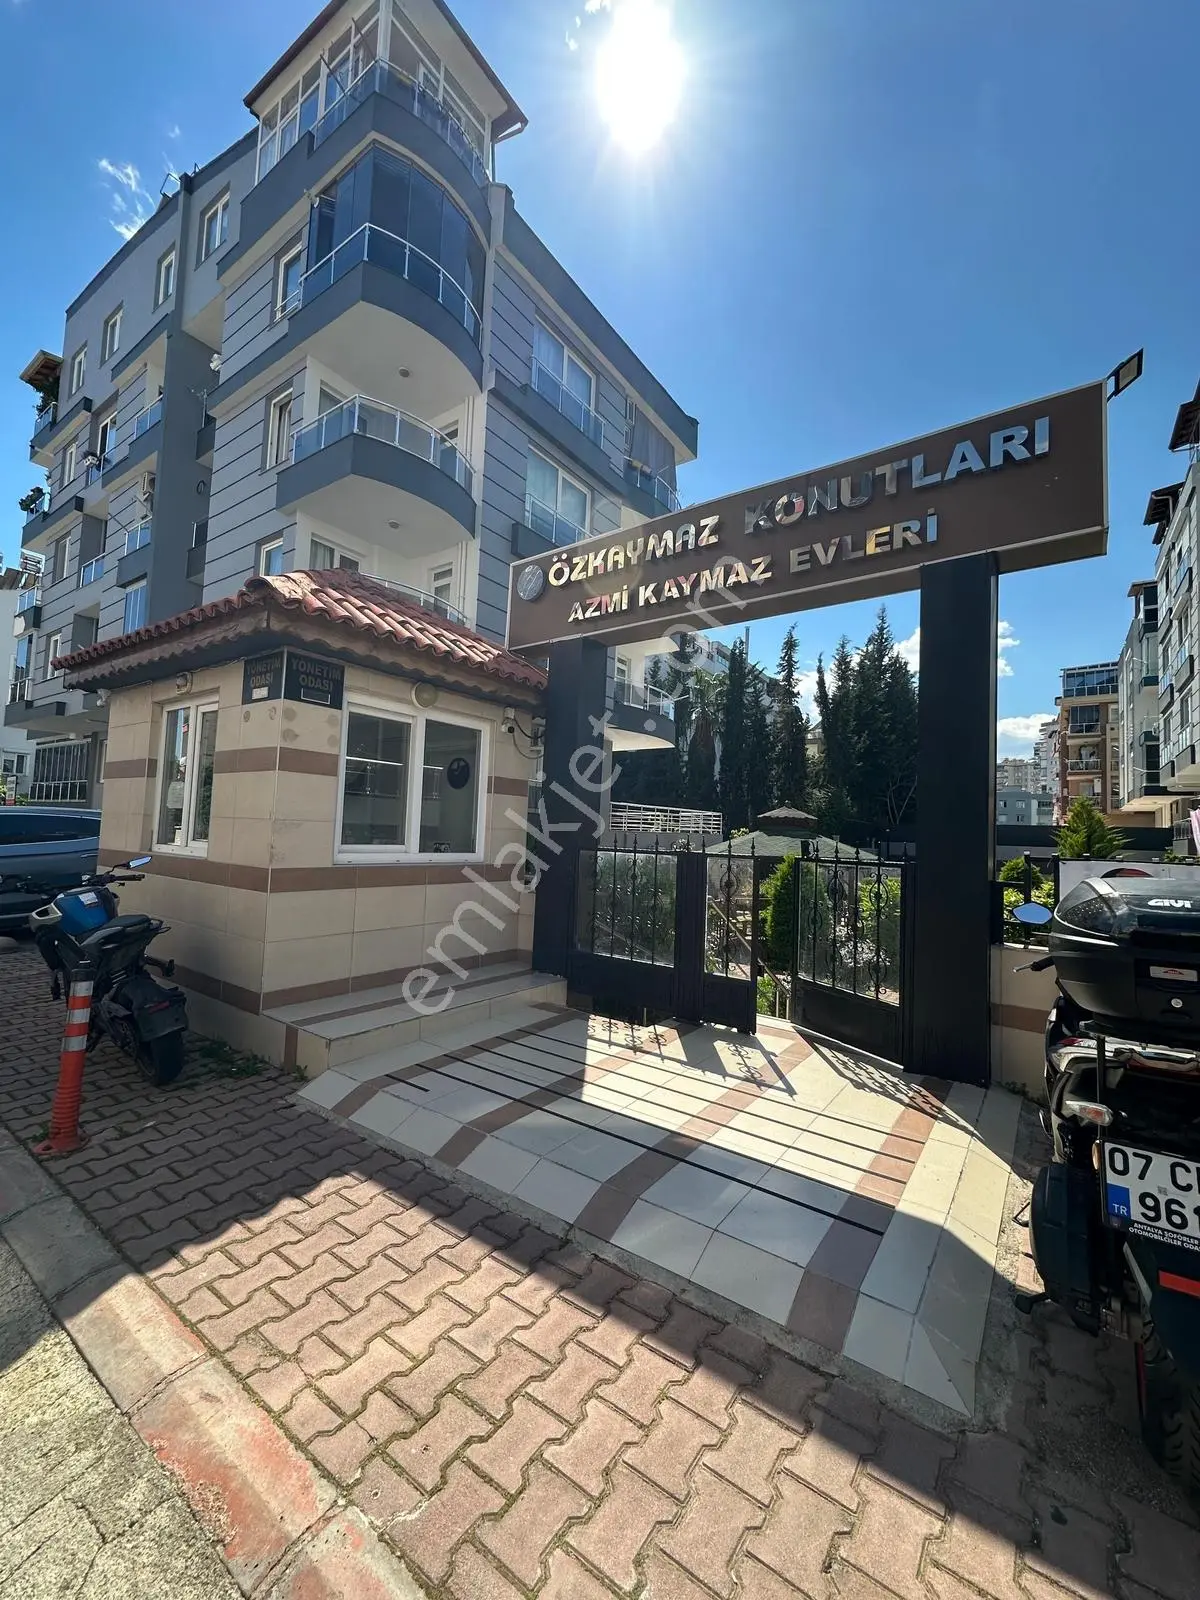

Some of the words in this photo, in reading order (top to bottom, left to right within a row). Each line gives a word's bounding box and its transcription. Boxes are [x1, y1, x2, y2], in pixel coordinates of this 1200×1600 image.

[548, 515, 720, 587] ÖZKAYMAZ
[744, 416, 1050, 534] KONUTLARI
[568, 584, 630, 623] AZMİ
[638, 553, 773, 607] KAYMAZ
[789, 507, 938, 574] EVLERİ
[1108, 1147, 1153, 1181] 07
[1170, 1161, 1200, 1195] C
[1112, 1203, 1128, 1216] TR
[1133, 1222, 1163, 1236] ANTALYA
